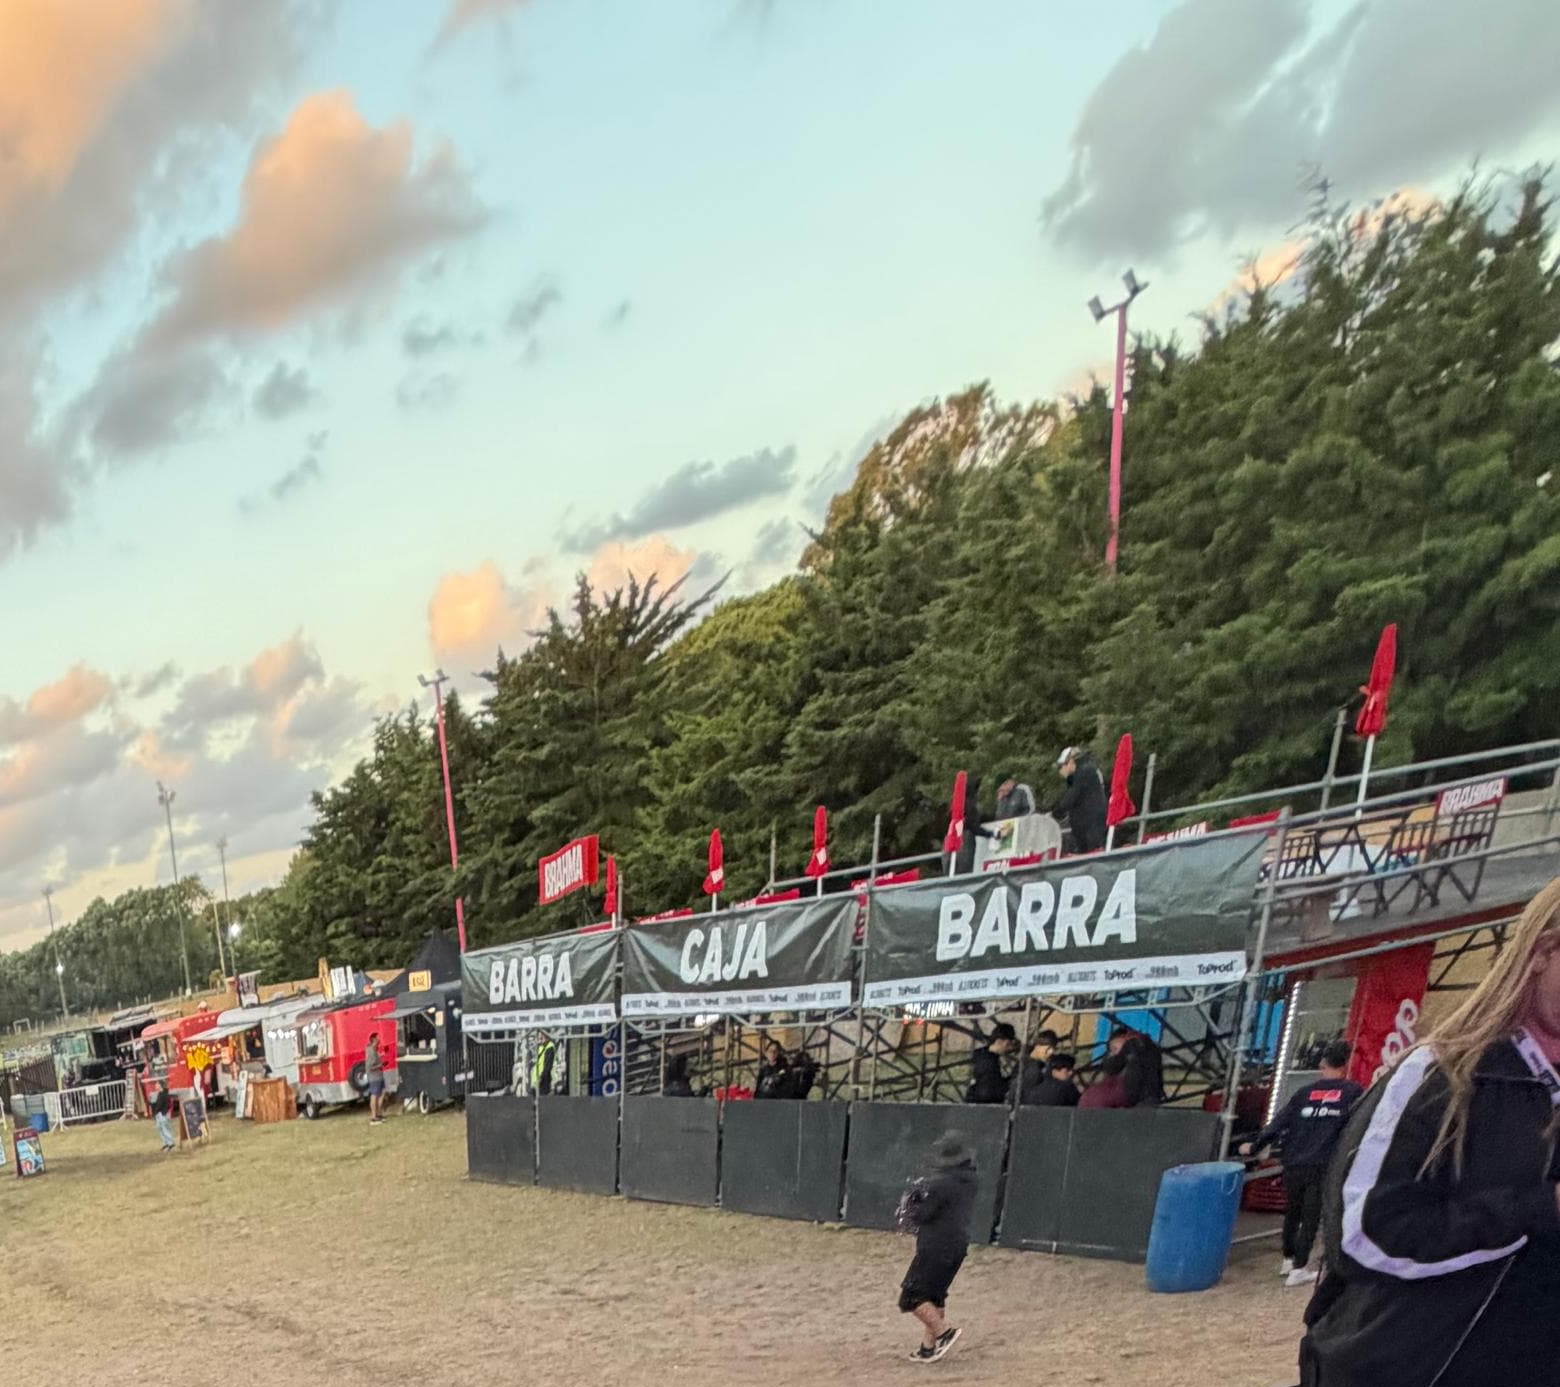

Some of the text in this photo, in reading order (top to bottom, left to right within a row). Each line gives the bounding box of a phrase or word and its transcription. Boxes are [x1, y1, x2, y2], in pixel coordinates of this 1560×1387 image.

[935, 868, 1137, 962] BARRA
[490, 951, 574, 1004] BARRA
[680, 921, 769, 984] CAJA
